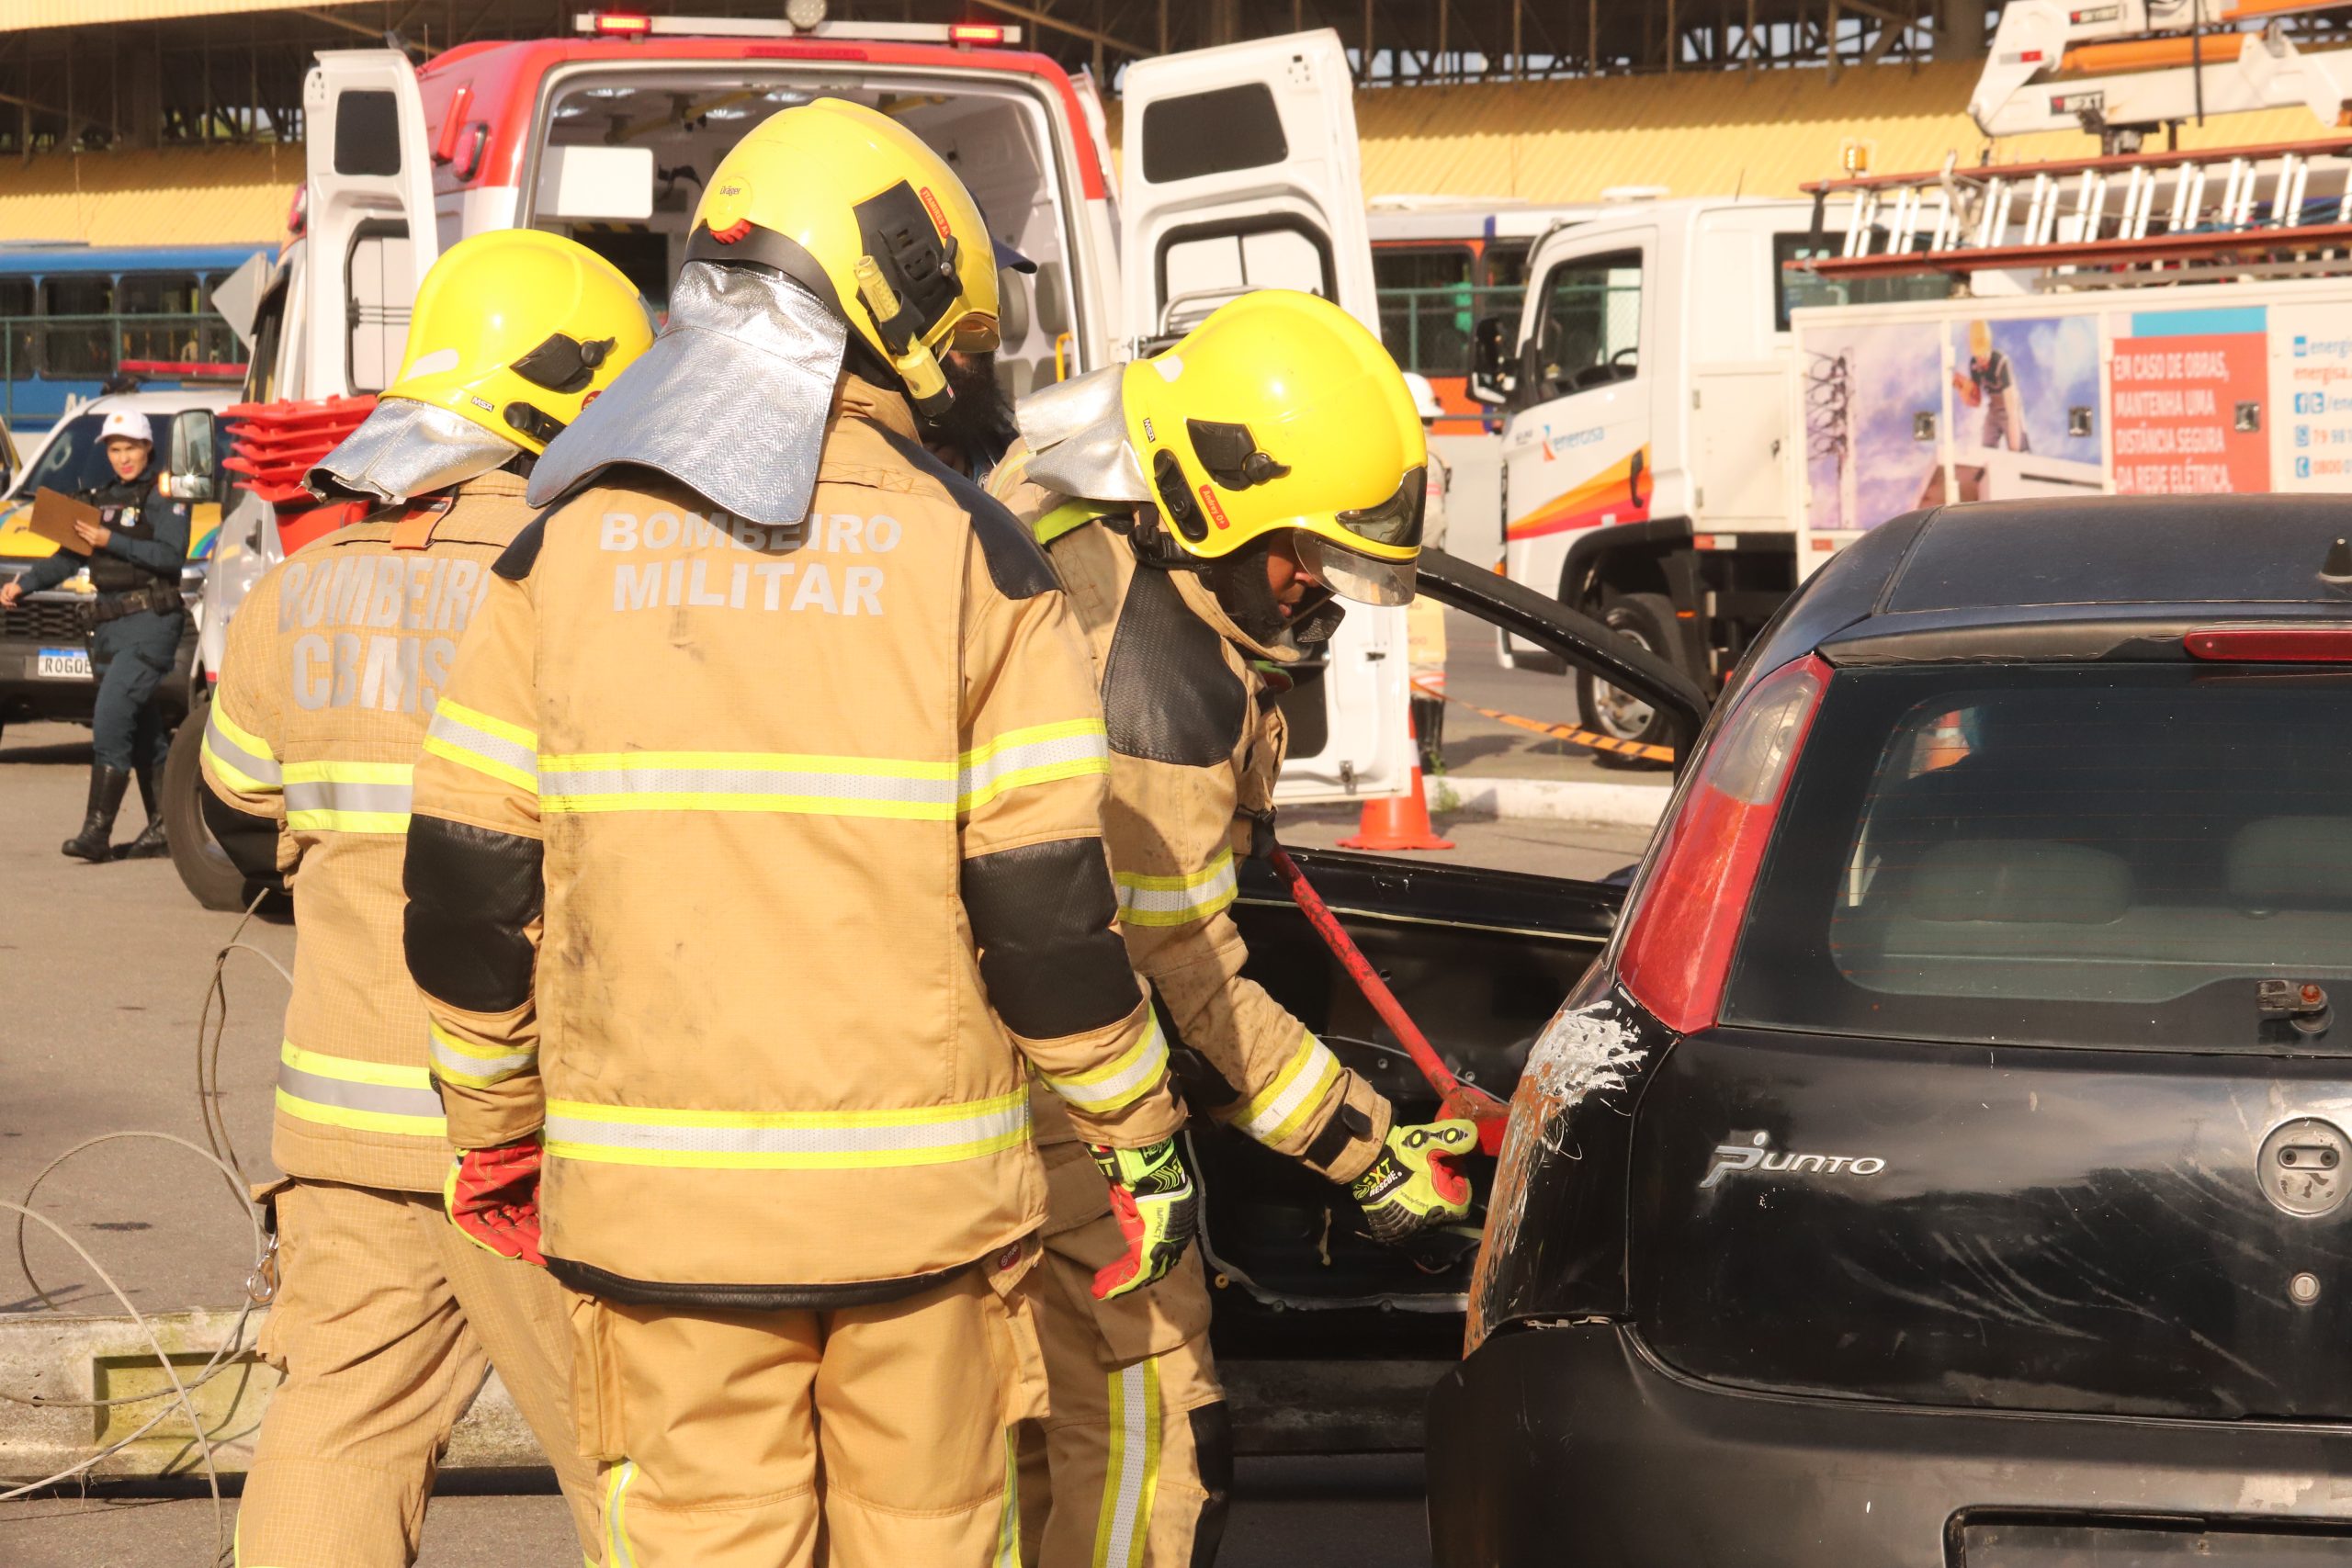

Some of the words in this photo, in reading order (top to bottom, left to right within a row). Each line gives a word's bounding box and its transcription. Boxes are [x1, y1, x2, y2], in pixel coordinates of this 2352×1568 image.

[719, 186, 741, 197] Dräger
[922, 189, 945, 226] ITAMIRES
[2132, 353, 2165, 380] CASO
[2166, 352, 2183, 379] DE
[2185, 350, 2231, 383] OBRAS,
[472, 397, 493, 412] MSA
[2114, 389, 2183, 417] MANTENHA
[2184, 389, 2217, 415] UMA
[1144, 418, 1155, 443] MSA
[2115, 421, 2176, 455] DISTÂNCIA
[2177, 426, 2226, 453] SEGURA
[2116, 465, 2134, 492] DA
[2135, 464, 2168, 494] REDE
[1202, 491, 1219, 514] Andrey
[600, 512, 902, 554] BOMBEIRO
[613, 558, 884, 615] MILITAR
[1363, 1157, 1391, 1190] EXT
[1153, 1206, 1165, 1240] IMPACT
